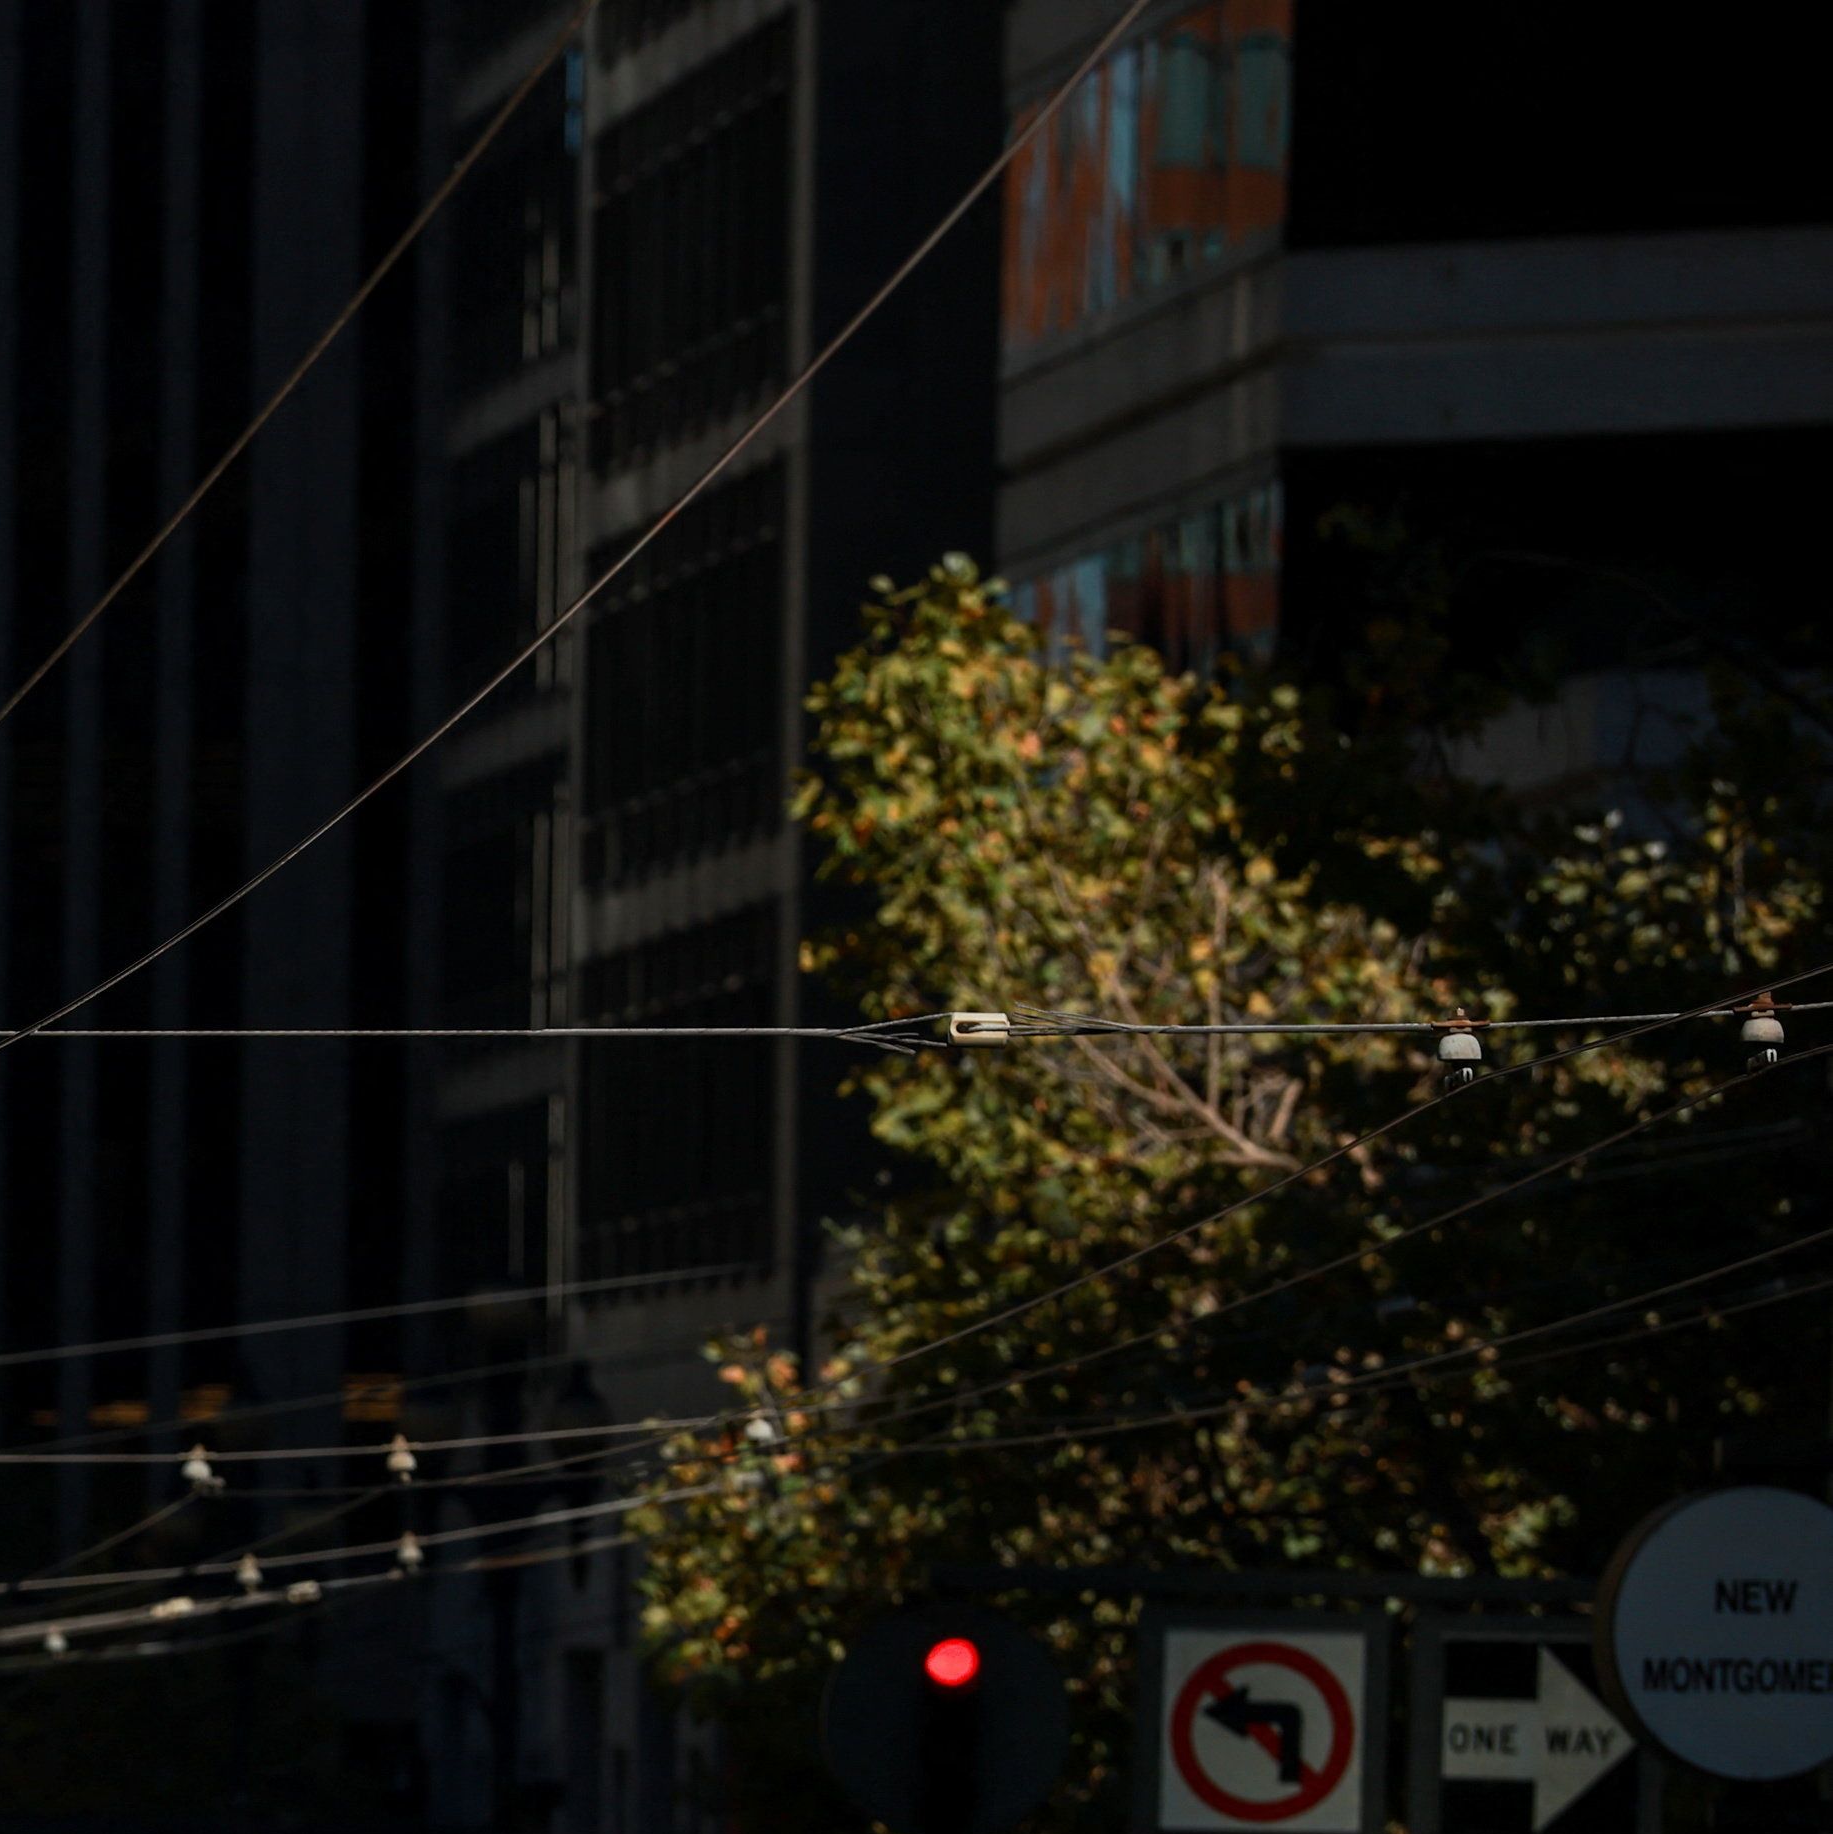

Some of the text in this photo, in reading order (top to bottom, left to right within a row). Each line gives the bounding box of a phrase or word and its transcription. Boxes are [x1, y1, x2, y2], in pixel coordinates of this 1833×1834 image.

[1714, 1580, 1798, 1615] NEW
[1642, 1659, 1833, 1694] MONTGOME
[1448, 1724, 1616, 1757] ONE WAY
